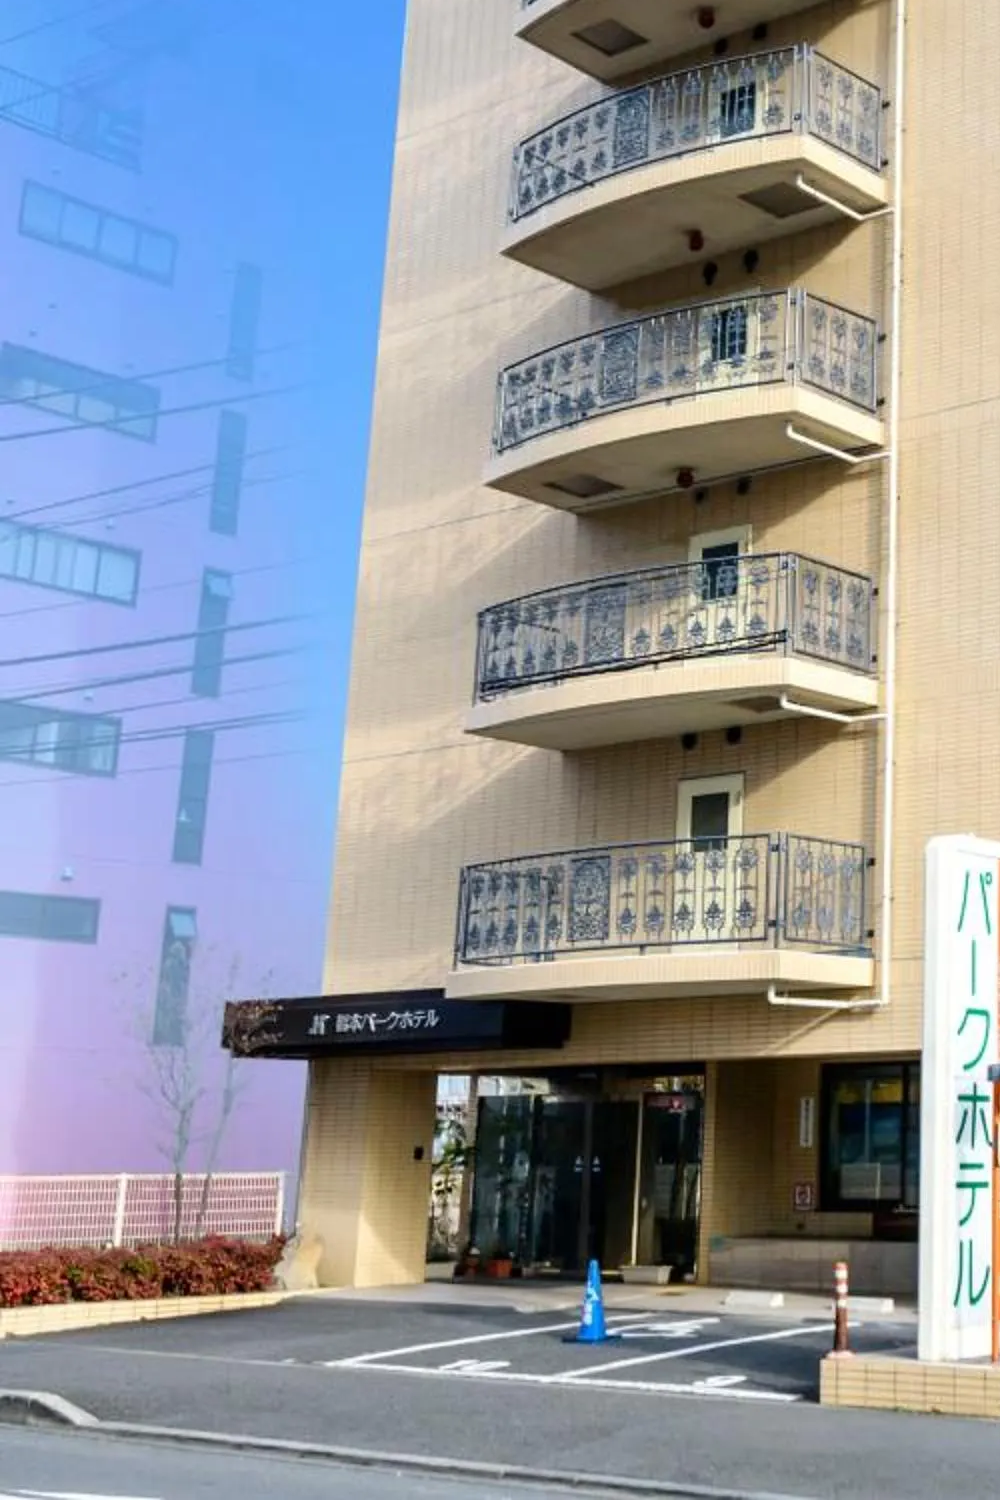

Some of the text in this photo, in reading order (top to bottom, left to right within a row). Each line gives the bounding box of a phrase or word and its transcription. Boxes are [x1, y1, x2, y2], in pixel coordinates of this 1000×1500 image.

[954, 870, 993, 1308] パークホテル
